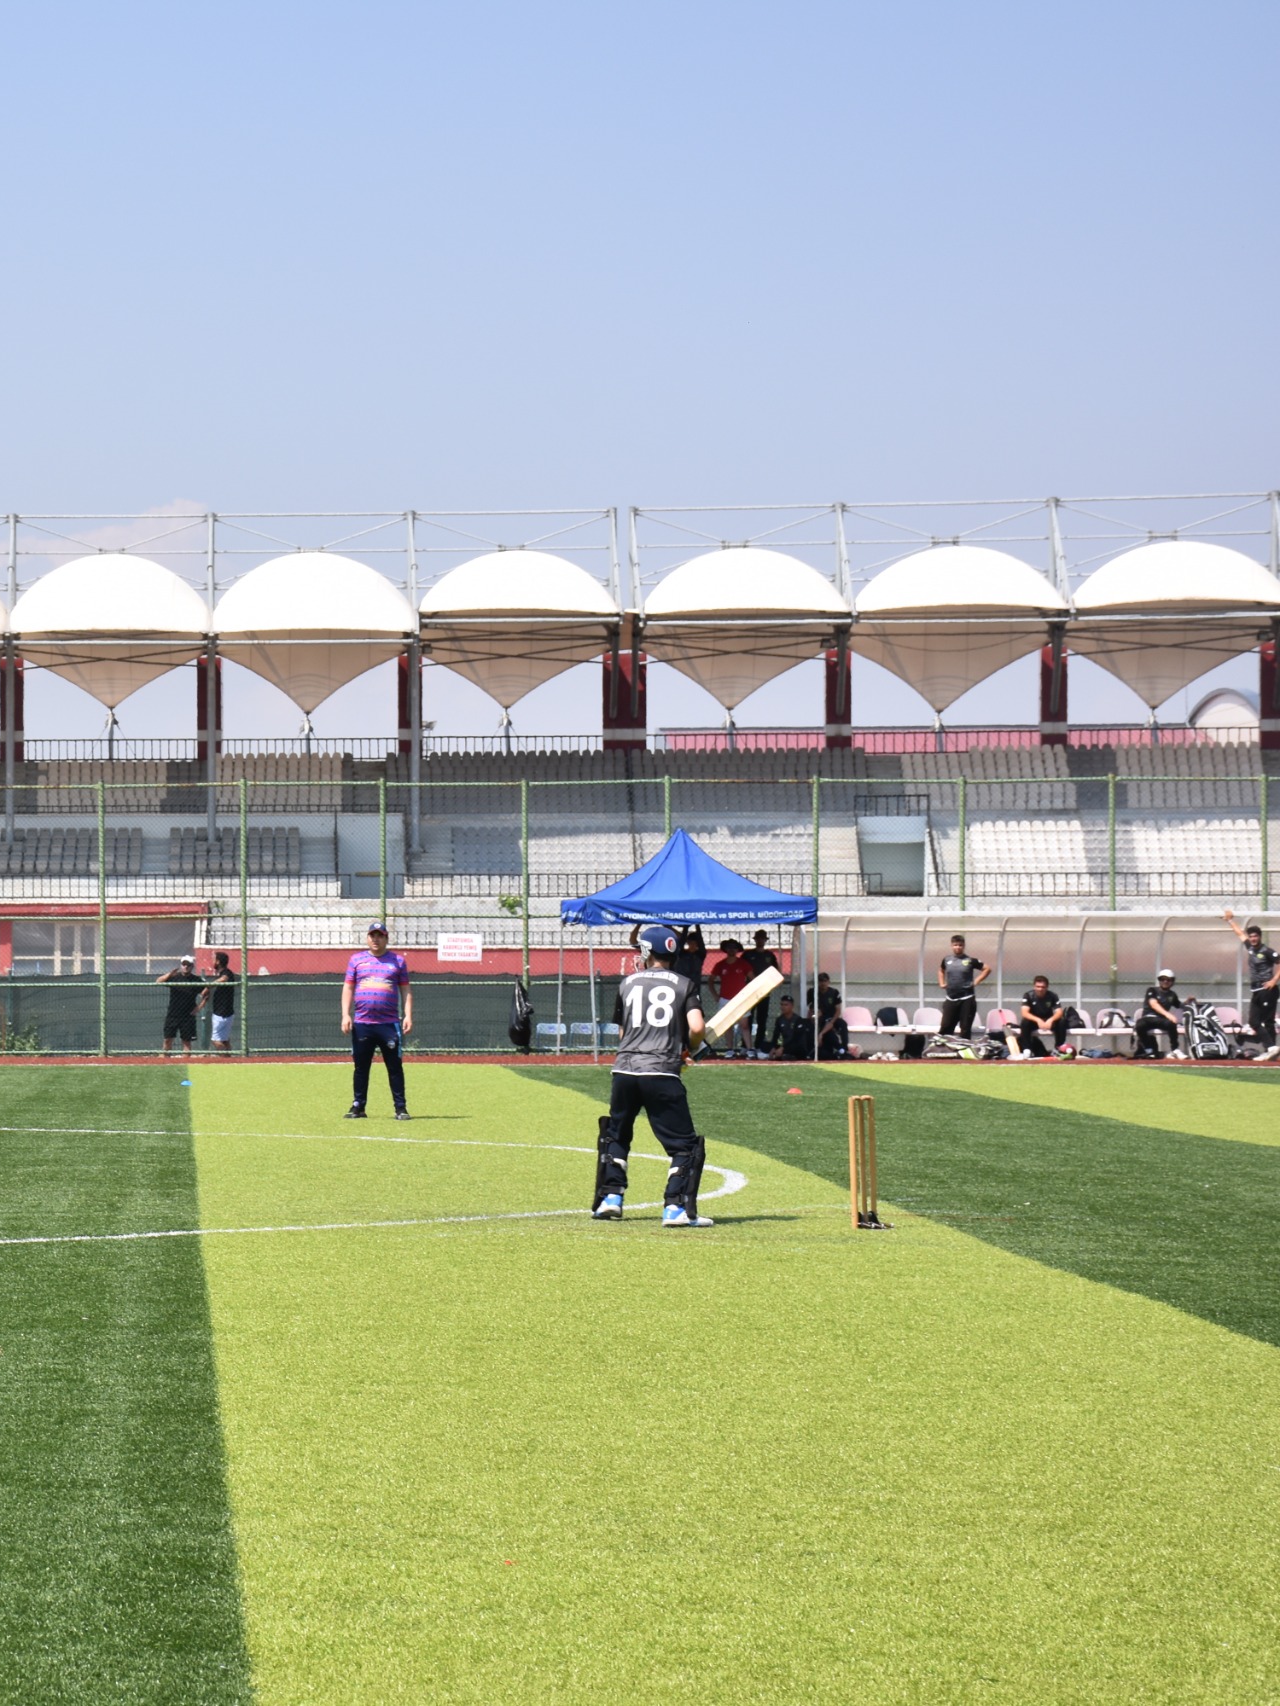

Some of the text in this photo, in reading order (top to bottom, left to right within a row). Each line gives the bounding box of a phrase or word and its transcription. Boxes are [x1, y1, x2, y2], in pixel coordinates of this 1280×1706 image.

[685, 911, 717, 920] GENÇLİK
[728, 911, 748, 919] SPOR
[625, 985, 676, 1028] 18
